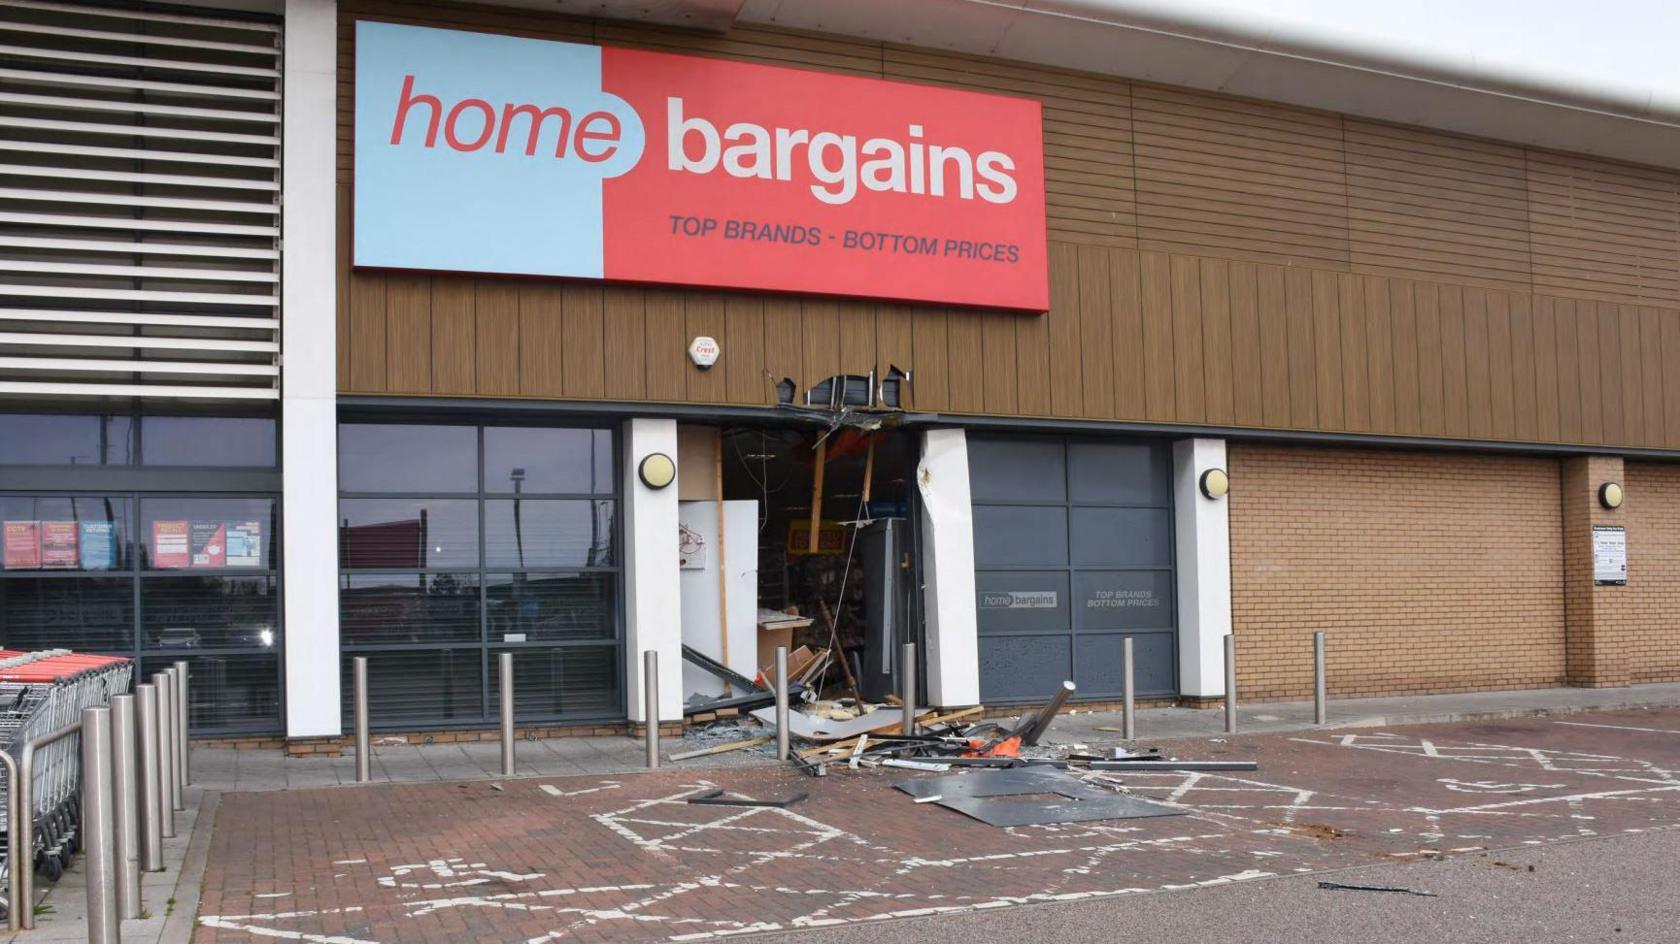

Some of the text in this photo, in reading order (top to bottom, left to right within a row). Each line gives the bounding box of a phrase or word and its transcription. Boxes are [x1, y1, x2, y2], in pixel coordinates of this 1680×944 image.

[390, 75, 1018, 205] home bargains
[669, 216, 717, 237] TOP
[724, 220, 821, 246] BRANDS
[842, 230, 938, 256] BOTTOM
[943, 239, 1020, 263] PRICES
[984, 594, 1055, 608] home bargains
[1096, 591, 1152, 599] TOP BRANDS
[1087, 599, 1160, 607] BOTTOM PRICES
